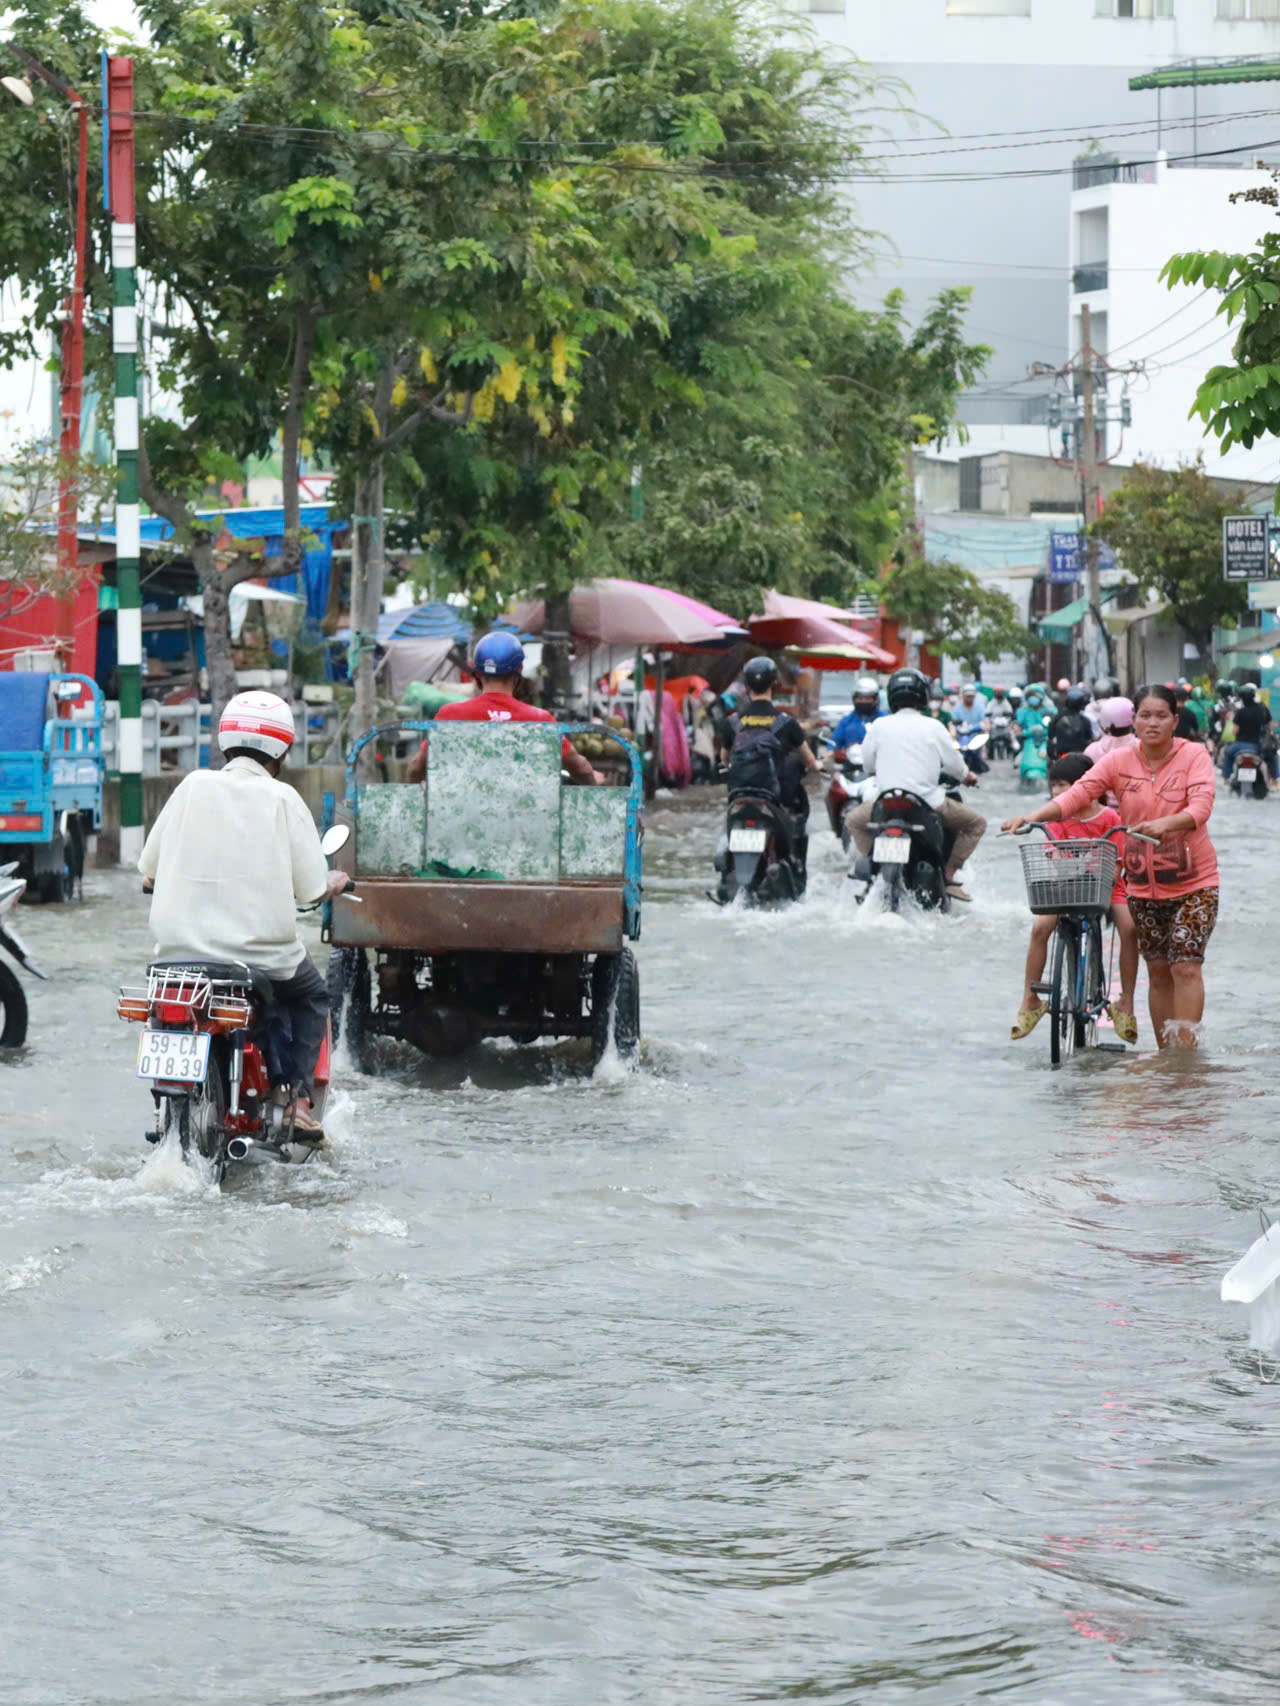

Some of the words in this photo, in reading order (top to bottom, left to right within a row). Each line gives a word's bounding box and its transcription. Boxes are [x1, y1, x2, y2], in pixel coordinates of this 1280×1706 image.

[1227, 521, 1263, 537] HOTEL
[150, 1034, 198, 1056] 59-CA
[141, 1056, 202, 1078] 018.39
